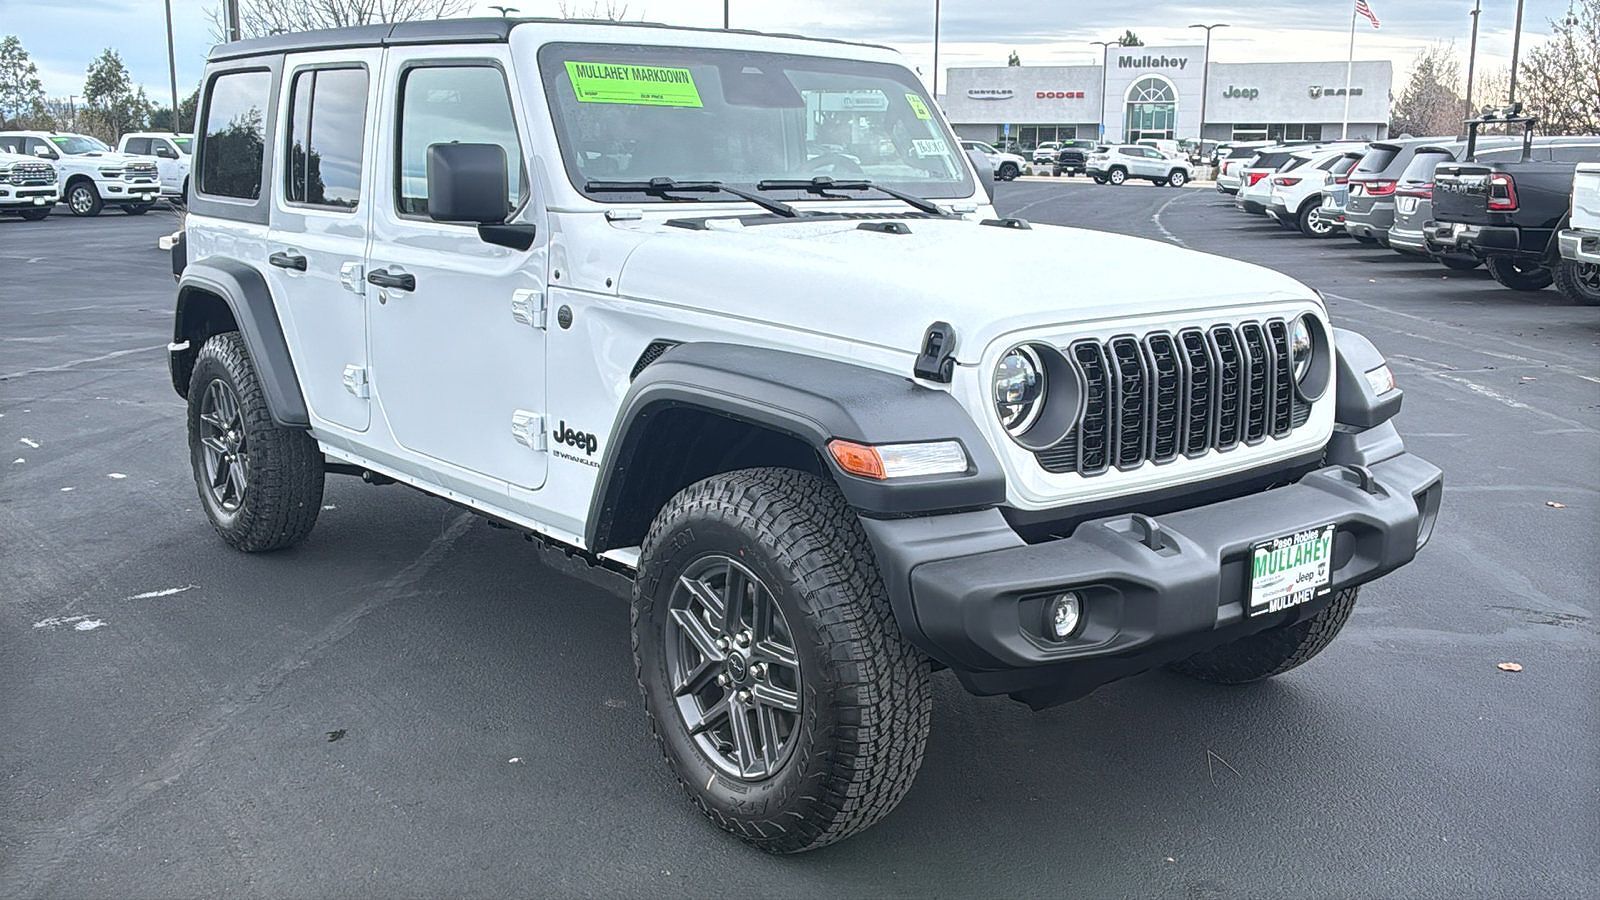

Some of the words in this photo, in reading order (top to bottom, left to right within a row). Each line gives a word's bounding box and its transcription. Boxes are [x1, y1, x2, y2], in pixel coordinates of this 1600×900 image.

[1118, 55, 1188, 70] Mullahey
[575, 64, 629, 81] MULLAHEY
[632, 68, 690, 84] MARKDOWN
[1223, 85, 1259, 101] Jeep
[1324, 88, 1363, 96] RAM
[1442, 184, 1468, 194] RAM
[553, 420, 597, 456] Jeep
[560, 452, 600, 469] WRANGLER
[1273, 537, 1293, 550] Paso
[1293, 530, 1319, 545] Robles
[1254, 538, 1329, 578] MULLAHEY
[1295, 571, 1314, 584] Jeep
[1269, 588, 1315, 613] MULLAHEY
